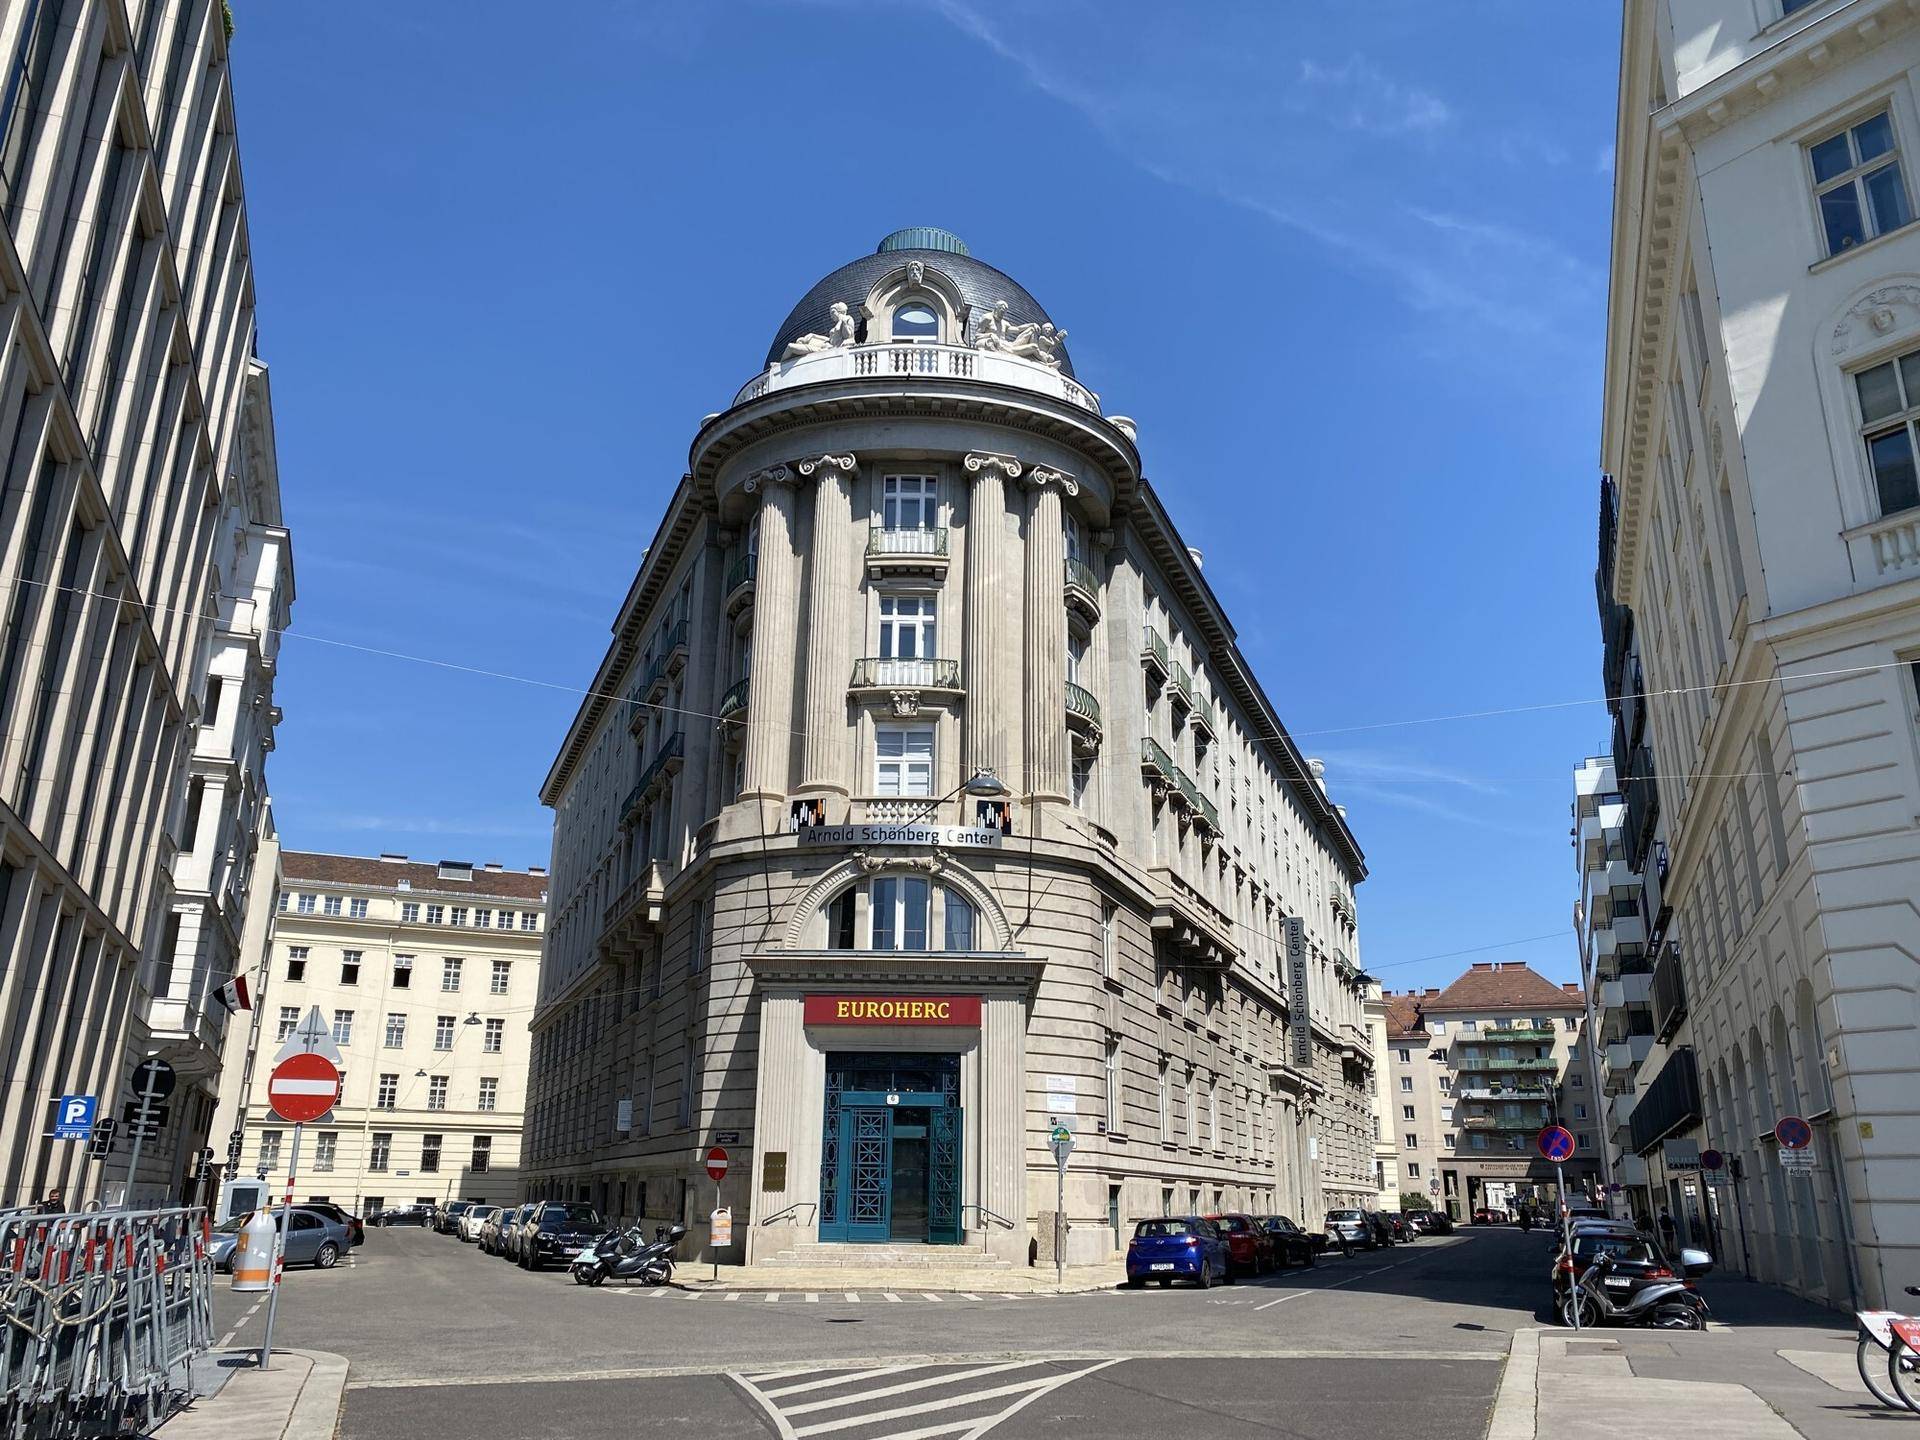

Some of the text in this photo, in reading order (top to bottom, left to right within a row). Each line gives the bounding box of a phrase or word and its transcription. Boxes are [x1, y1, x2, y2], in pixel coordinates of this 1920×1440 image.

[807, 828, 994, 845] Arnold Schönberg Center
[1289, 920, 1307, 1064] Arnold Schönberg Center
[836, 1001, 950, 1018] EUROHERC
